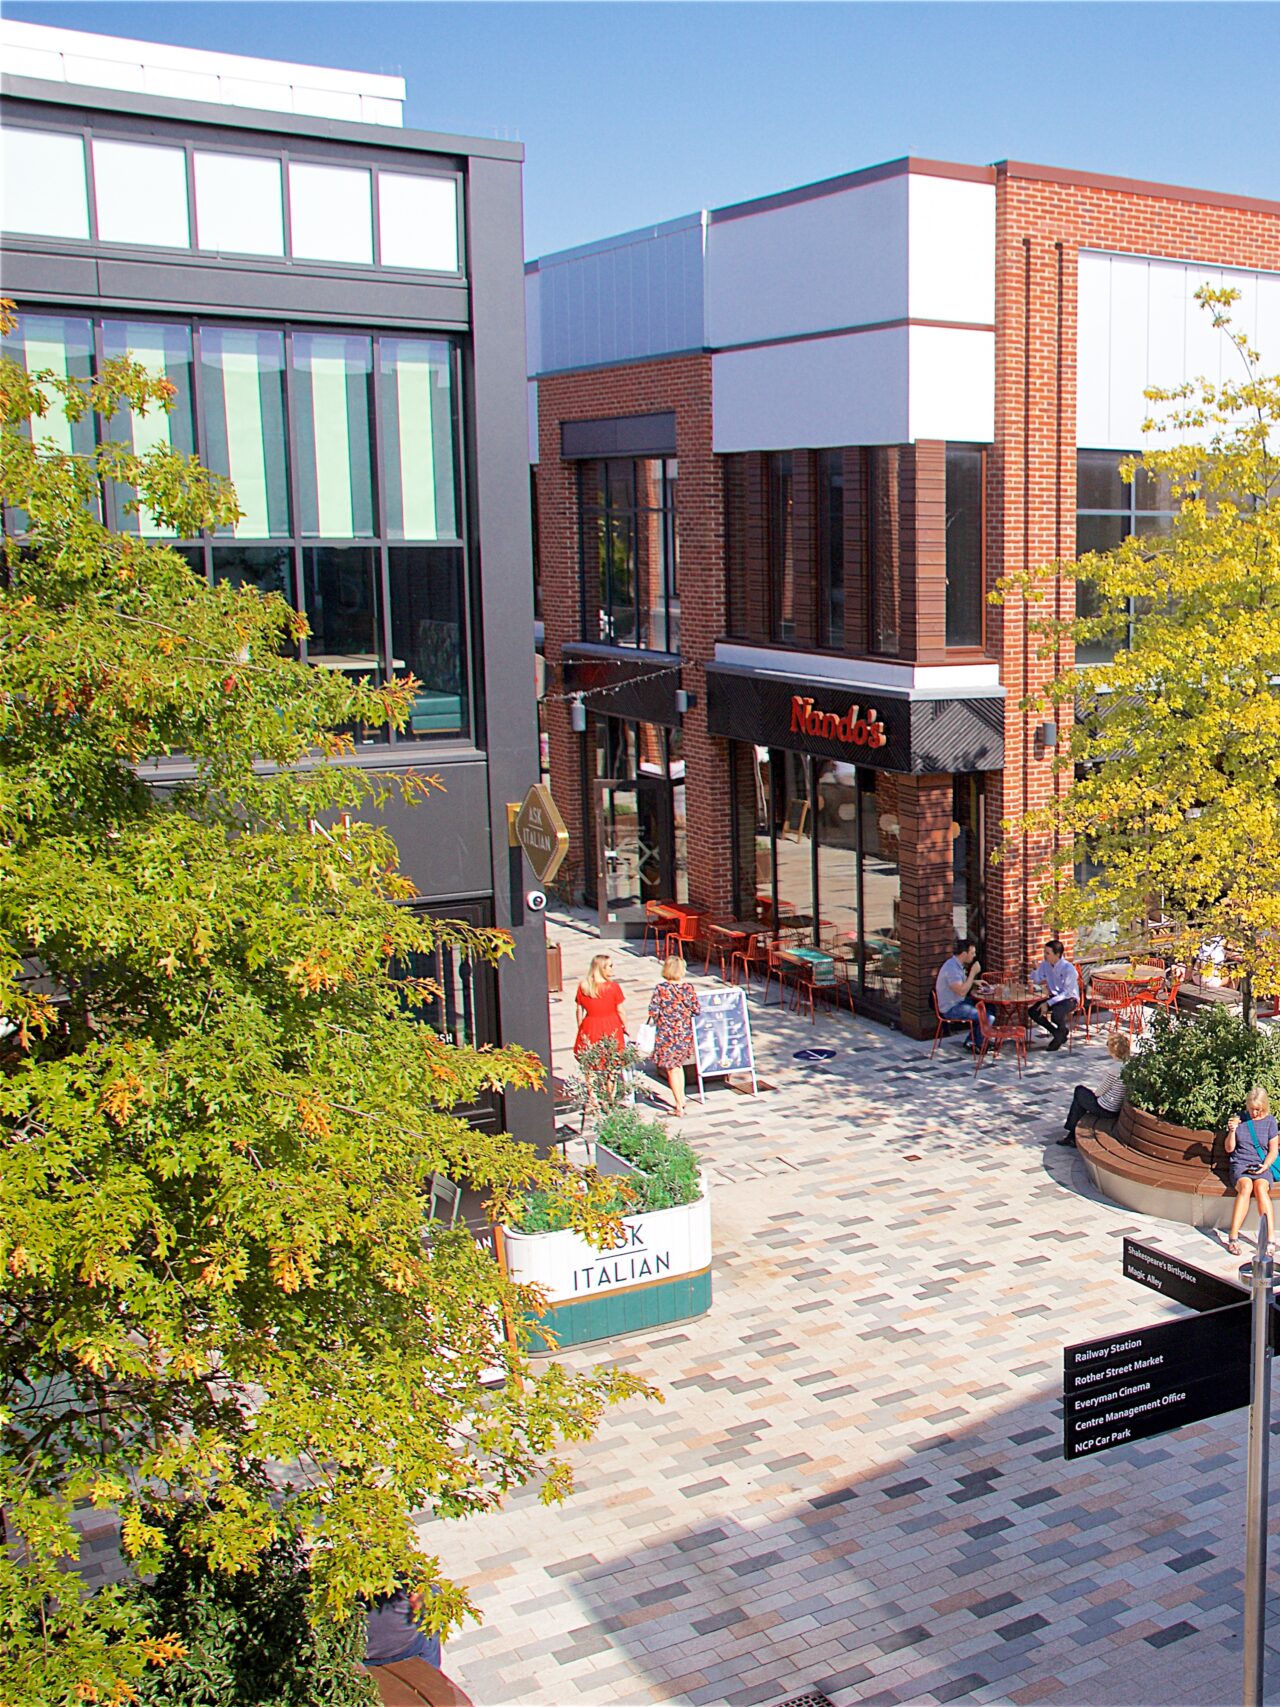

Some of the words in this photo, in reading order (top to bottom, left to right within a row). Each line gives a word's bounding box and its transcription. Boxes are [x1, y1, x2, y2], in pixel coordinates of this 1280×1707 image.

[790, 696, 887, 748] Nando's
[529, 806, 542, 825] ASK
[523, 828, 551, 851] ITALIAN
[600, 1222, 644, 1250] SK
[573, 1251, 670, 1291] ITALIAN
[1128, 1246, 1166, 1270] Shakespeare's
[1167, 1264, 1197, 1284] Birthplace
[1128, 1265, 1146, 1280] Magic
[1146, 1274, 1162, 1288] Alley
[1075, 1347, 1110, 1362] Railway
[1110, 1339, 1142, 1354] Station
[1074, 1372, 1105, 1386] Rother
[1106, 1363, 1133, 1378] Street
[1134, 1354, 1164, 1370] Market
[1074, 1392, 1118, 1410] Everyman
[1118, 1382, 1150, 1397] Cinema
[1075, 1416, 1104, 1430] Centre
[1105, 1399, 1161, 1422] Management
[1162, 1392, 1186, 1405] Office
[1074, 1440, 1094, 1452] NCP
[1096, 1436, 1110, 1446] Car
[1112, 1428, 1132, 1441] Park
